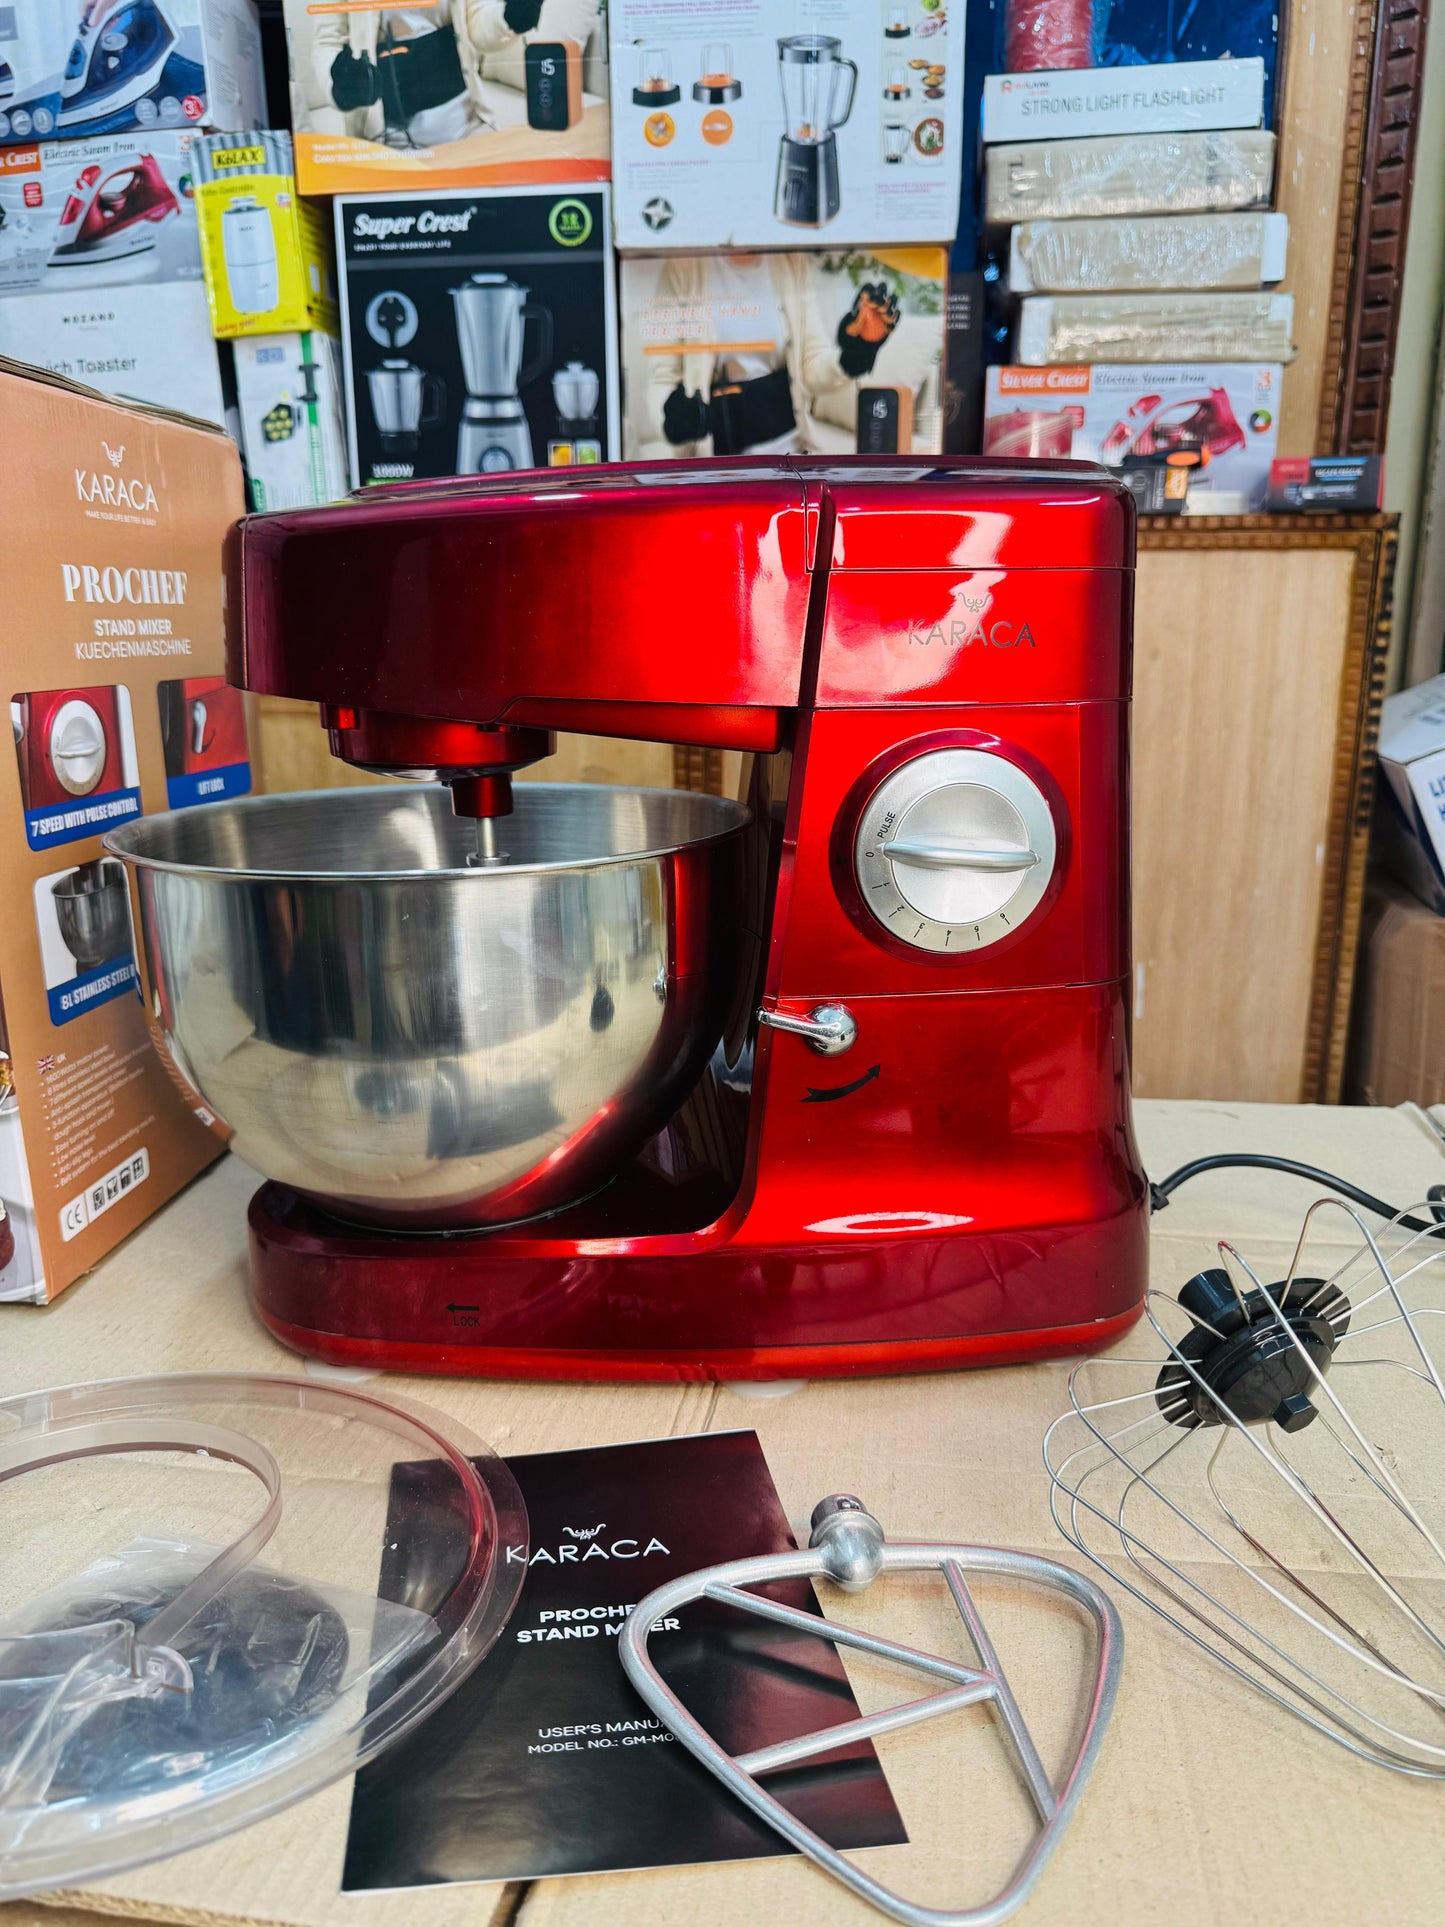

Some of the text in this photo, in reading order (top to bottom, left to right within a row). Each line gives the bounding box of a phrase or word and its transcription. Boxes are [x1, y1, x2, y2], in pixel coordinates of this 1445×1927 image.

[1021, 87, 1226, 115] STRONG LIGHT FLASHLIGHT
[353, 212, 416, 240] Super
[77, 359, 136, 374] Toaster
[75, 468, 159, 512] KARACA
[61, 564, 187, 605] PROCHEF
[94, 619, 172, 636] STAND MIXER
[908, 618, 1036, 648] KARACA
[75, 639, 192, 660] KUECHENMASCHINE
[30, 798, 138, 837] 7 SPEED WITH PULSE CONTROL
[877, 811, 896, 839] PULSE
[897, 904, 905, 912] 2
[73, 975, 112, 1004] STAINLESS
[111, 968, 131, 989] STEEL
[453, 1315, 480, 1327] LOCK
[506, 1537, 671, 1566] KARACA
[540, 1604, 637, 1623] PROCHE
[517, 1617, 681, 1643] STAND MER
[538, 1718, 665, 1739] USER'S MANU
[528, 1742, 584, 1754] MODEL
[621, 1732, 678, 1746] GM-MO
